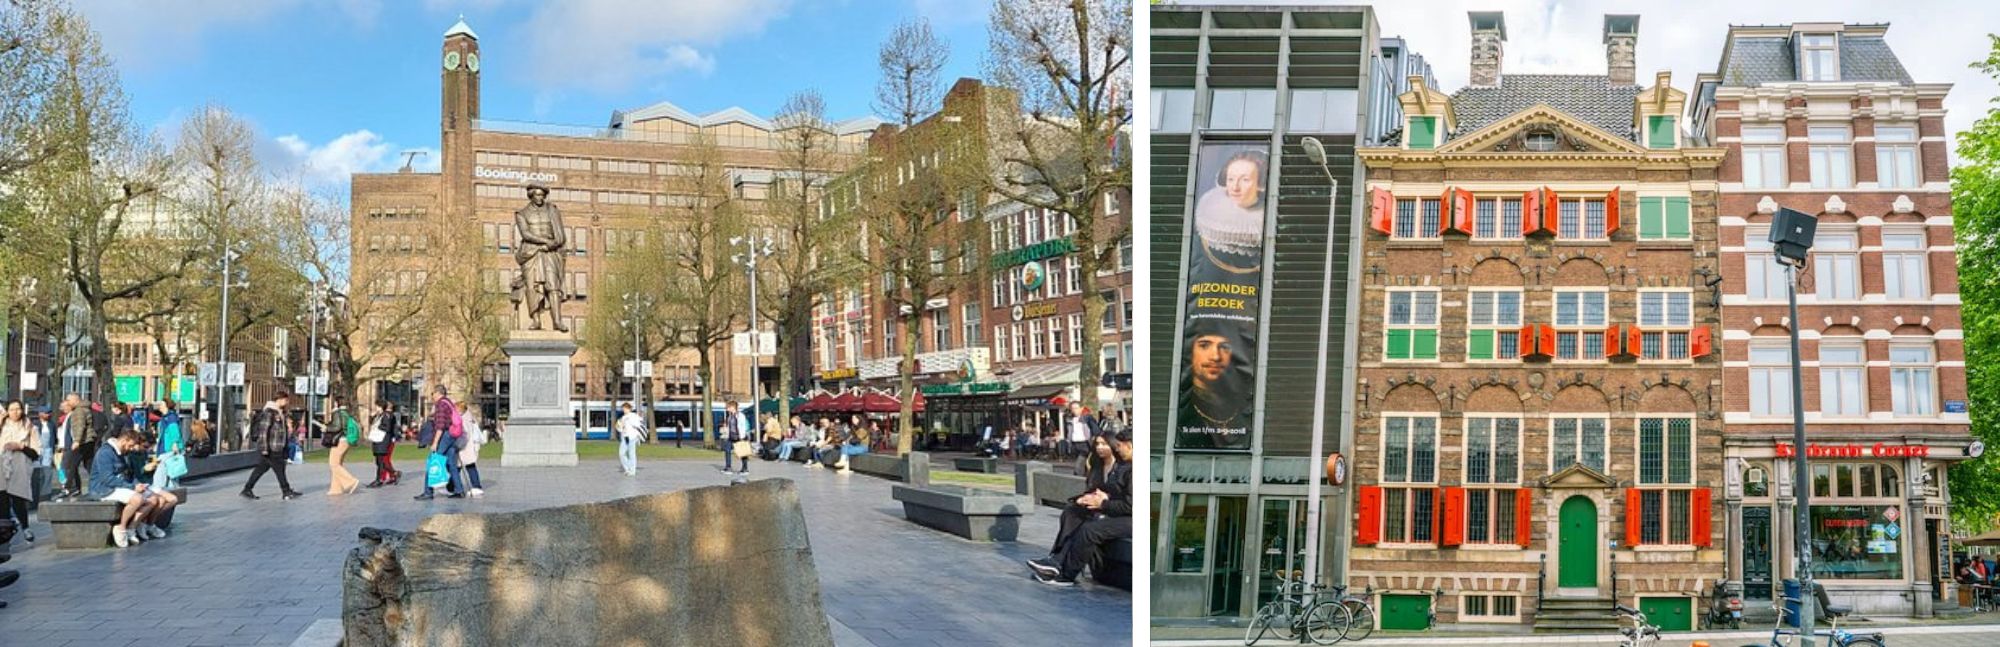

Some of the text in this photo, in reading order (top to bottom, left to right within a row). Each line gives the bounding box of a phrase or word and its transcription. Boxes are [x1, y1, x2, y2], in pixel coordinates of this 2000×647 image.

[475, 166, 557, 182] Booking.com
[1192, 283, 1256, 296] BIJZONDER
[1198, 298, 1245, 310] BEZOEK
[1871, 443, 1930, 456] Corner
